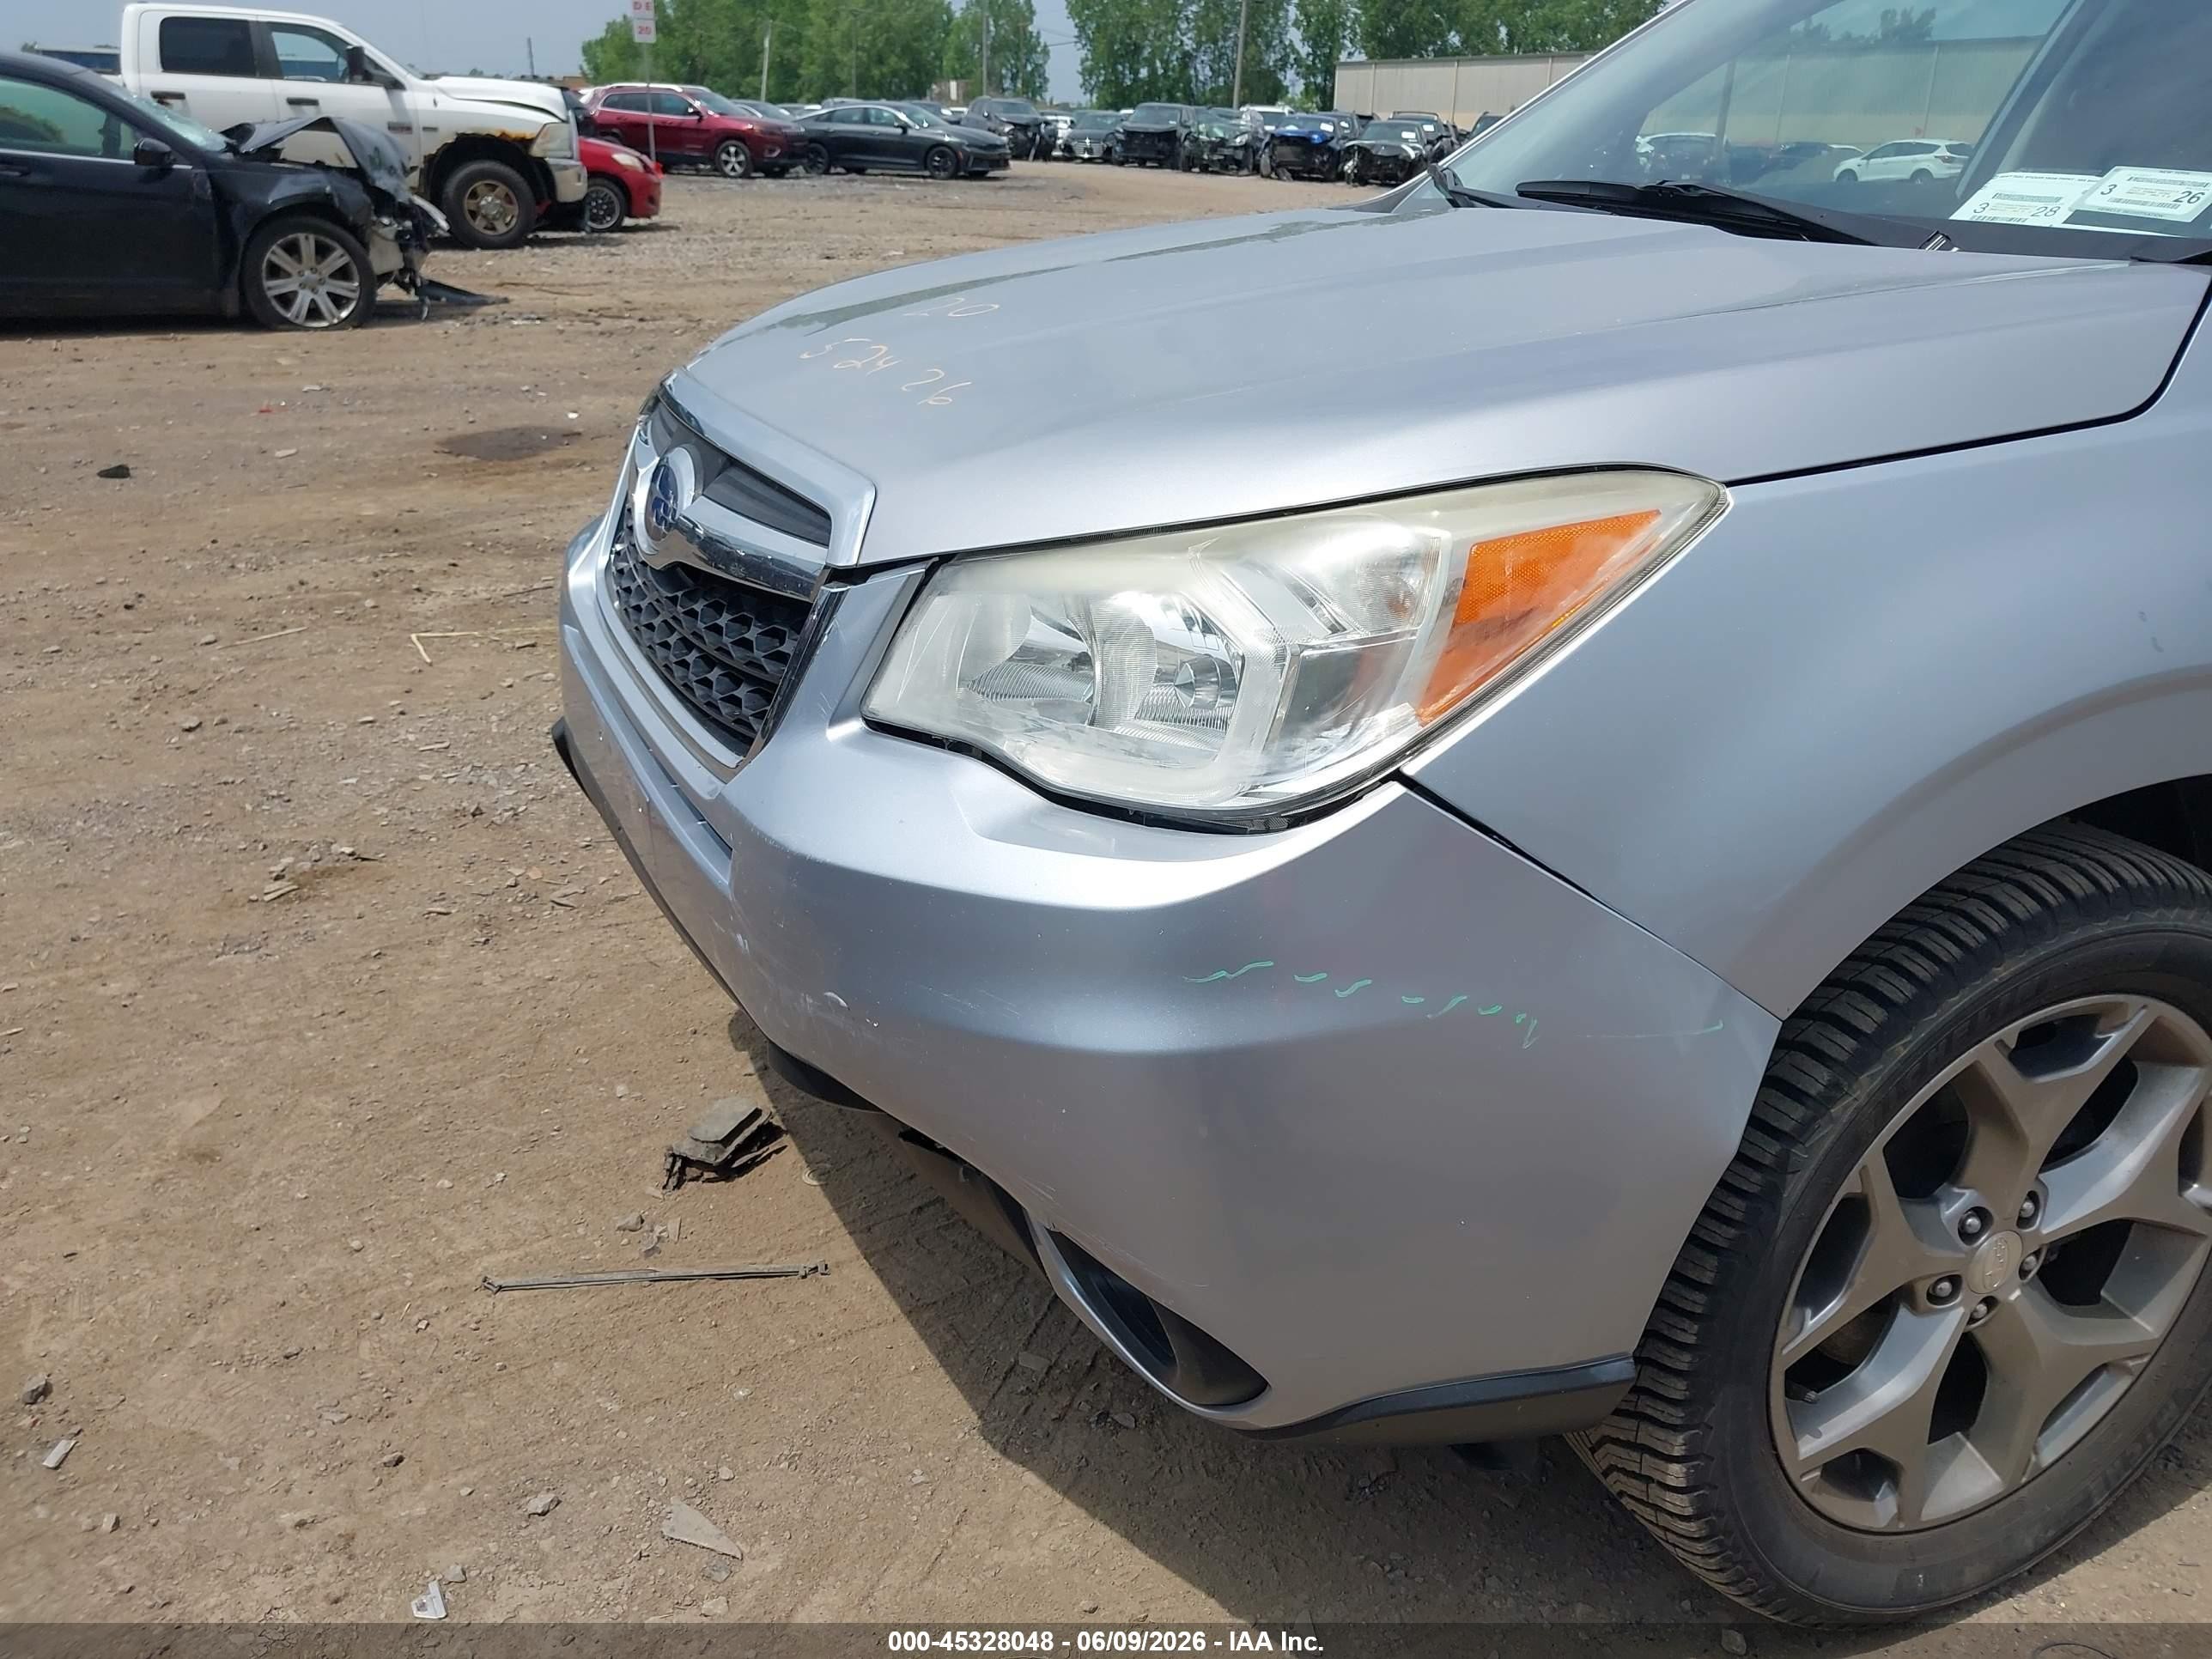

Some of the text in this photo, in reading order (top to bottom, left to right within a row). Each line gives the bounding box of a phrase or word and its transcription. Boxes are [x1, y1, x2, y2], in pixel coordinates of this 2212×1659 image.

[2100, 184, 2118, 196] 3
[2172, 190, 2206, 204] 26
[1972, 202, 1990, 214] 3
[2030, 205, 2062, 217] 28
